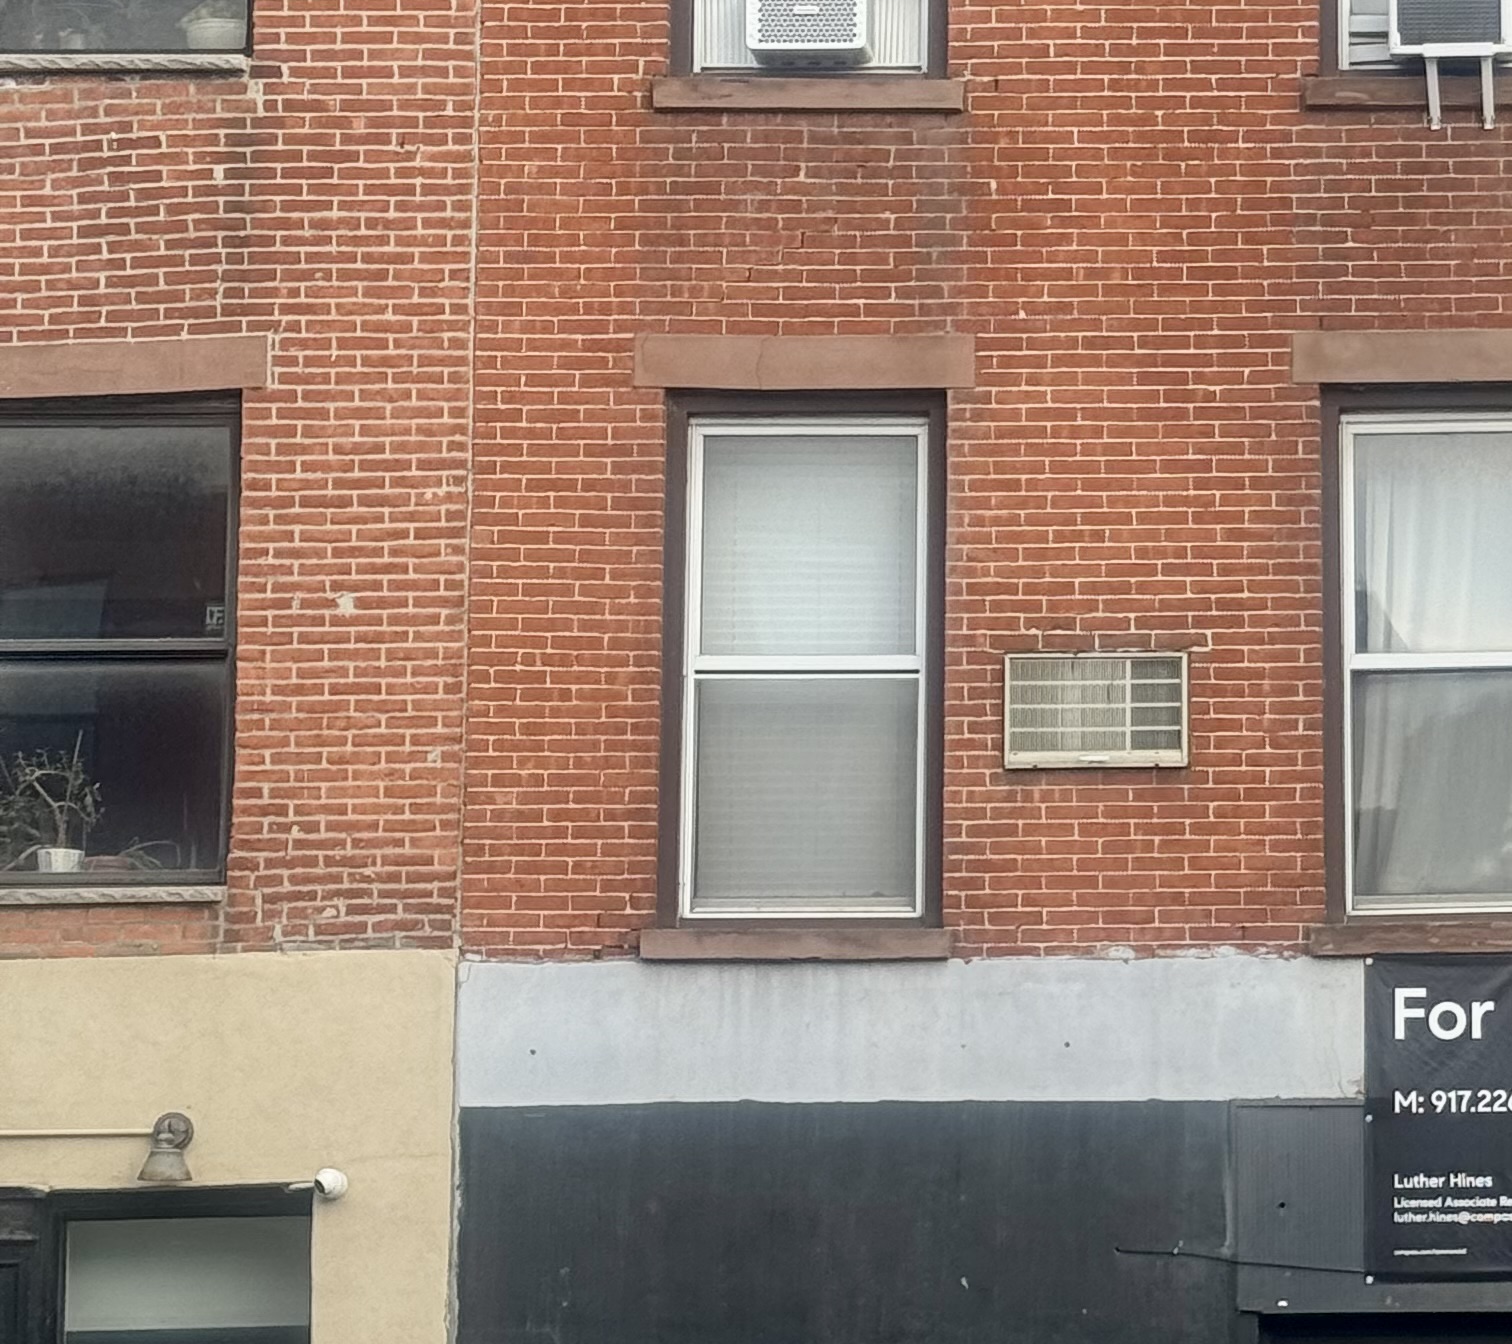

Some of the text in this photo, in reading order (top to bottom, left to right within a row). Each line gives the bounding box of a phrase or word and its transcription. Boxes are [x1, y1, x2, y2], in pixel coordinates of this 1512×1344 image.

[1394, 987, 1495, 1040] For
[1394, 1090, 1425, 1114] M:
[1393, 1172, 1493, 1189] Luther Hines
[1393, 1197, 1442, 1208] Licensed
[1444, 1196, 1498, 1208] Associate
